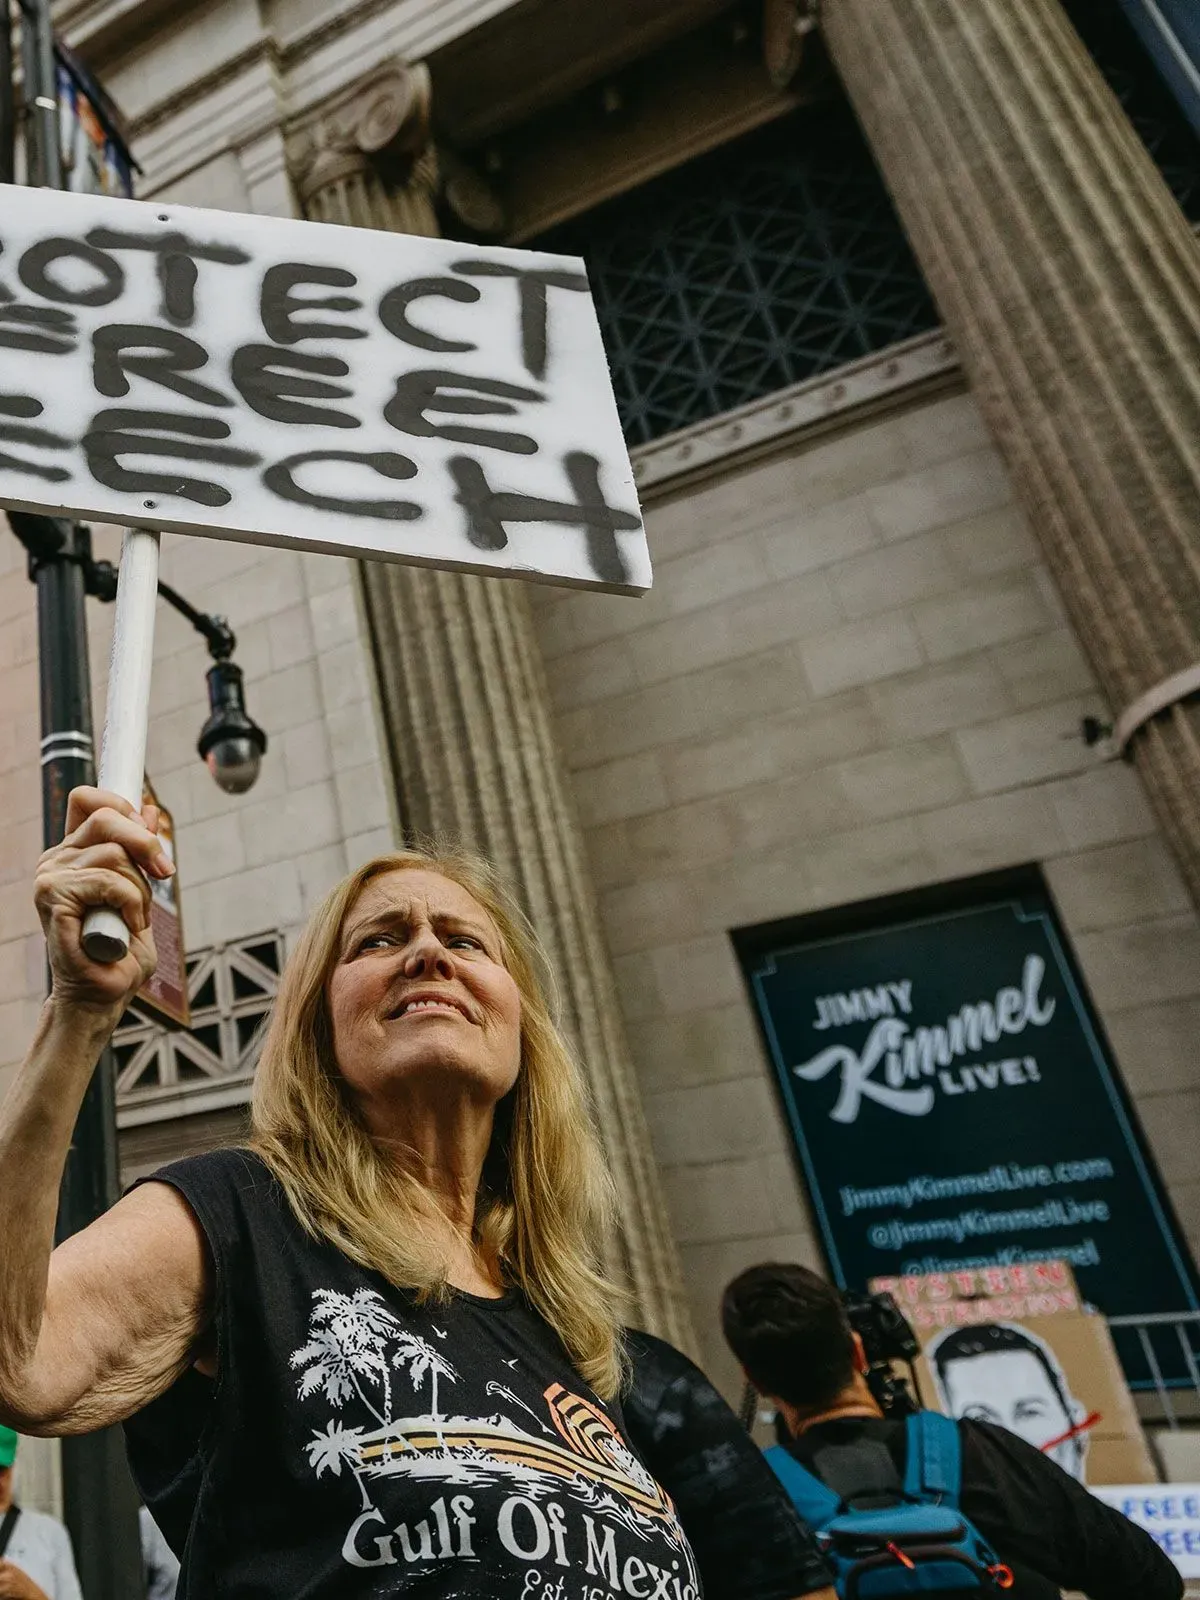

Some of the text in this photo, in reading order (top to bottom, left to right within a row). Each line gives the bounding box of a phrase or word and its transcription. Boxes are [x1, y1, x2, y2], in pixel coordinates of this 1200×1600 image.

[792, 953, 1057, 1125] Kimmel
[812, 978, 913, 1031] JIMMY
[937, 1055, 1042, 1096] LIVE!
[341, 1494, 702, 1600] Gulf Of Mexi
